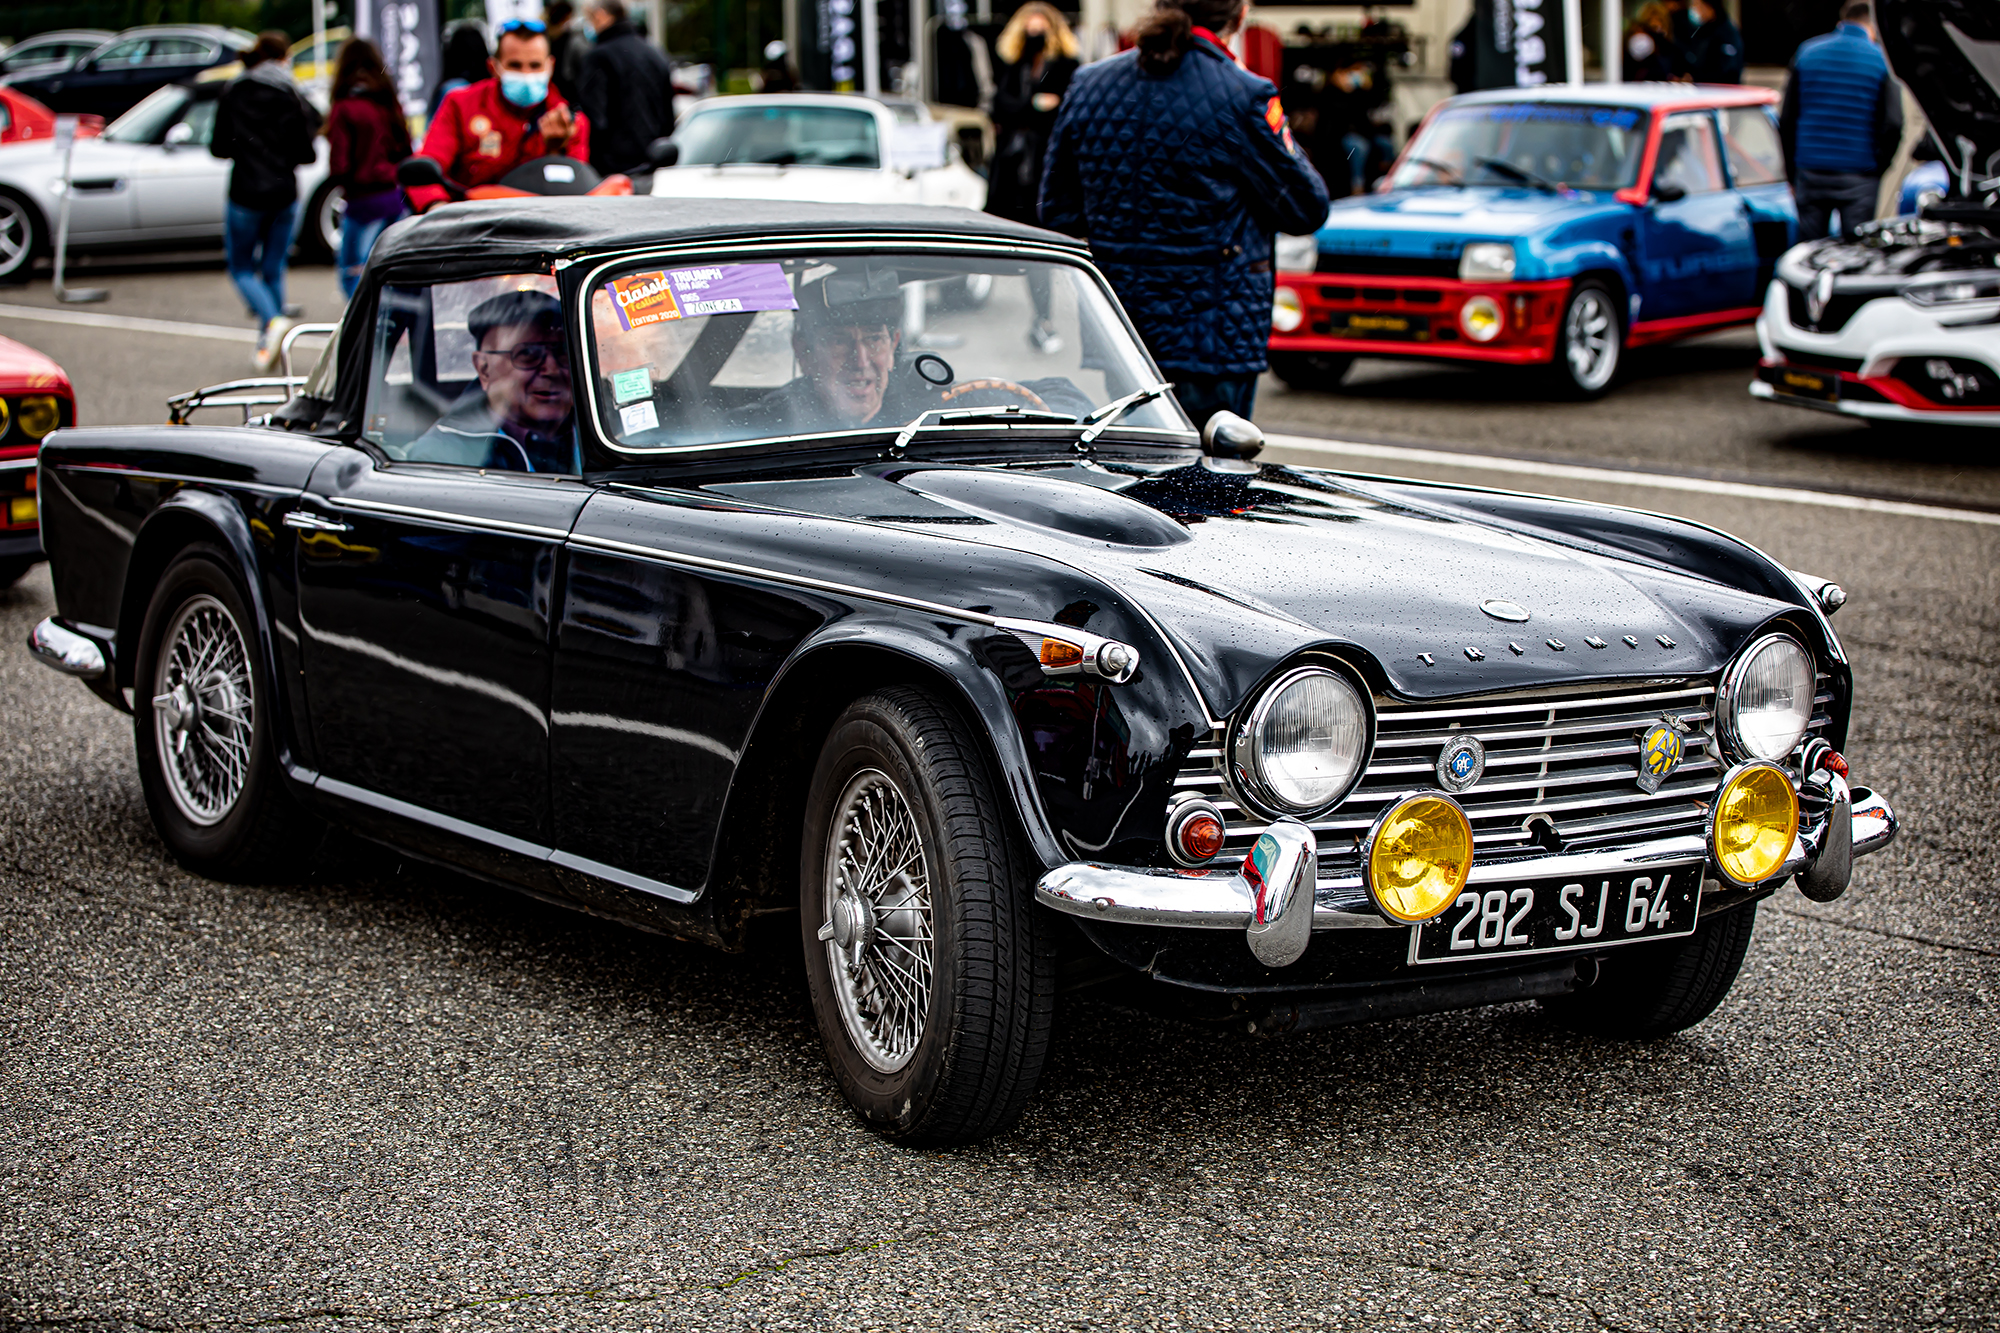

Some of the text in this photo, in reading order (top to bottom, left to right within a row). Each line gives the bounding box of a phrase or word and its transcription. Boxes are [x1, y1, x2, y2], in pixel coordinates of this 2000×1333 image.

[670, 268, 723, 283] TRIUMPH
[615, 277, 671, 308] Classic
[658, 310, 679, 320] 2020
[1417, 634, 1677, 667] TRIUMPH
[886, 742, 930, 844] TOYO
[1450, 874, 1671, 950] 282 SJ 64
